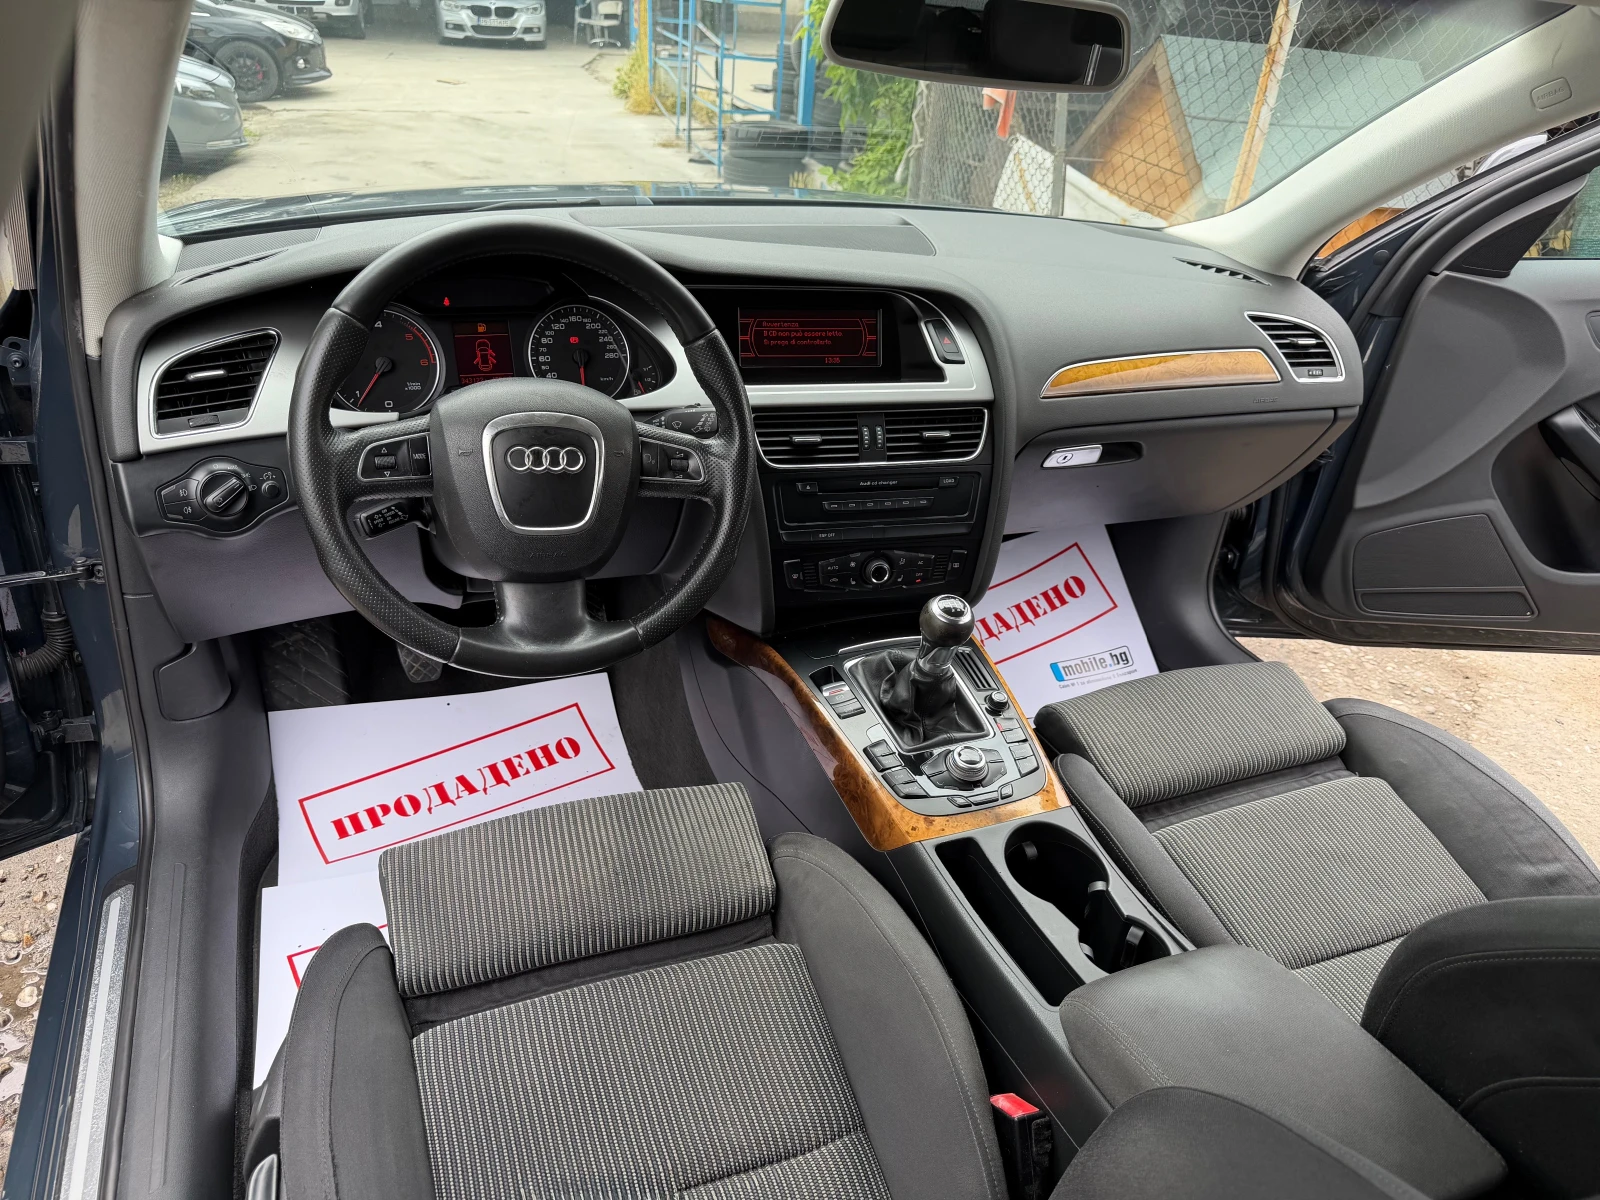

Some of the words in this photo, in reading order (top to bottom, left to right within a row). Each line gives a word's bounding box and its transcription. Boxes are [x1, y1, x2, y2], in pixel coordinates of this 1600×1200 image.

[974, 575, 1086, 647] ДАДЕНО
[1062, 651, 1130, 677] mobile.bg
[330, 736, 582, 840] ПРОДАДЕНО
